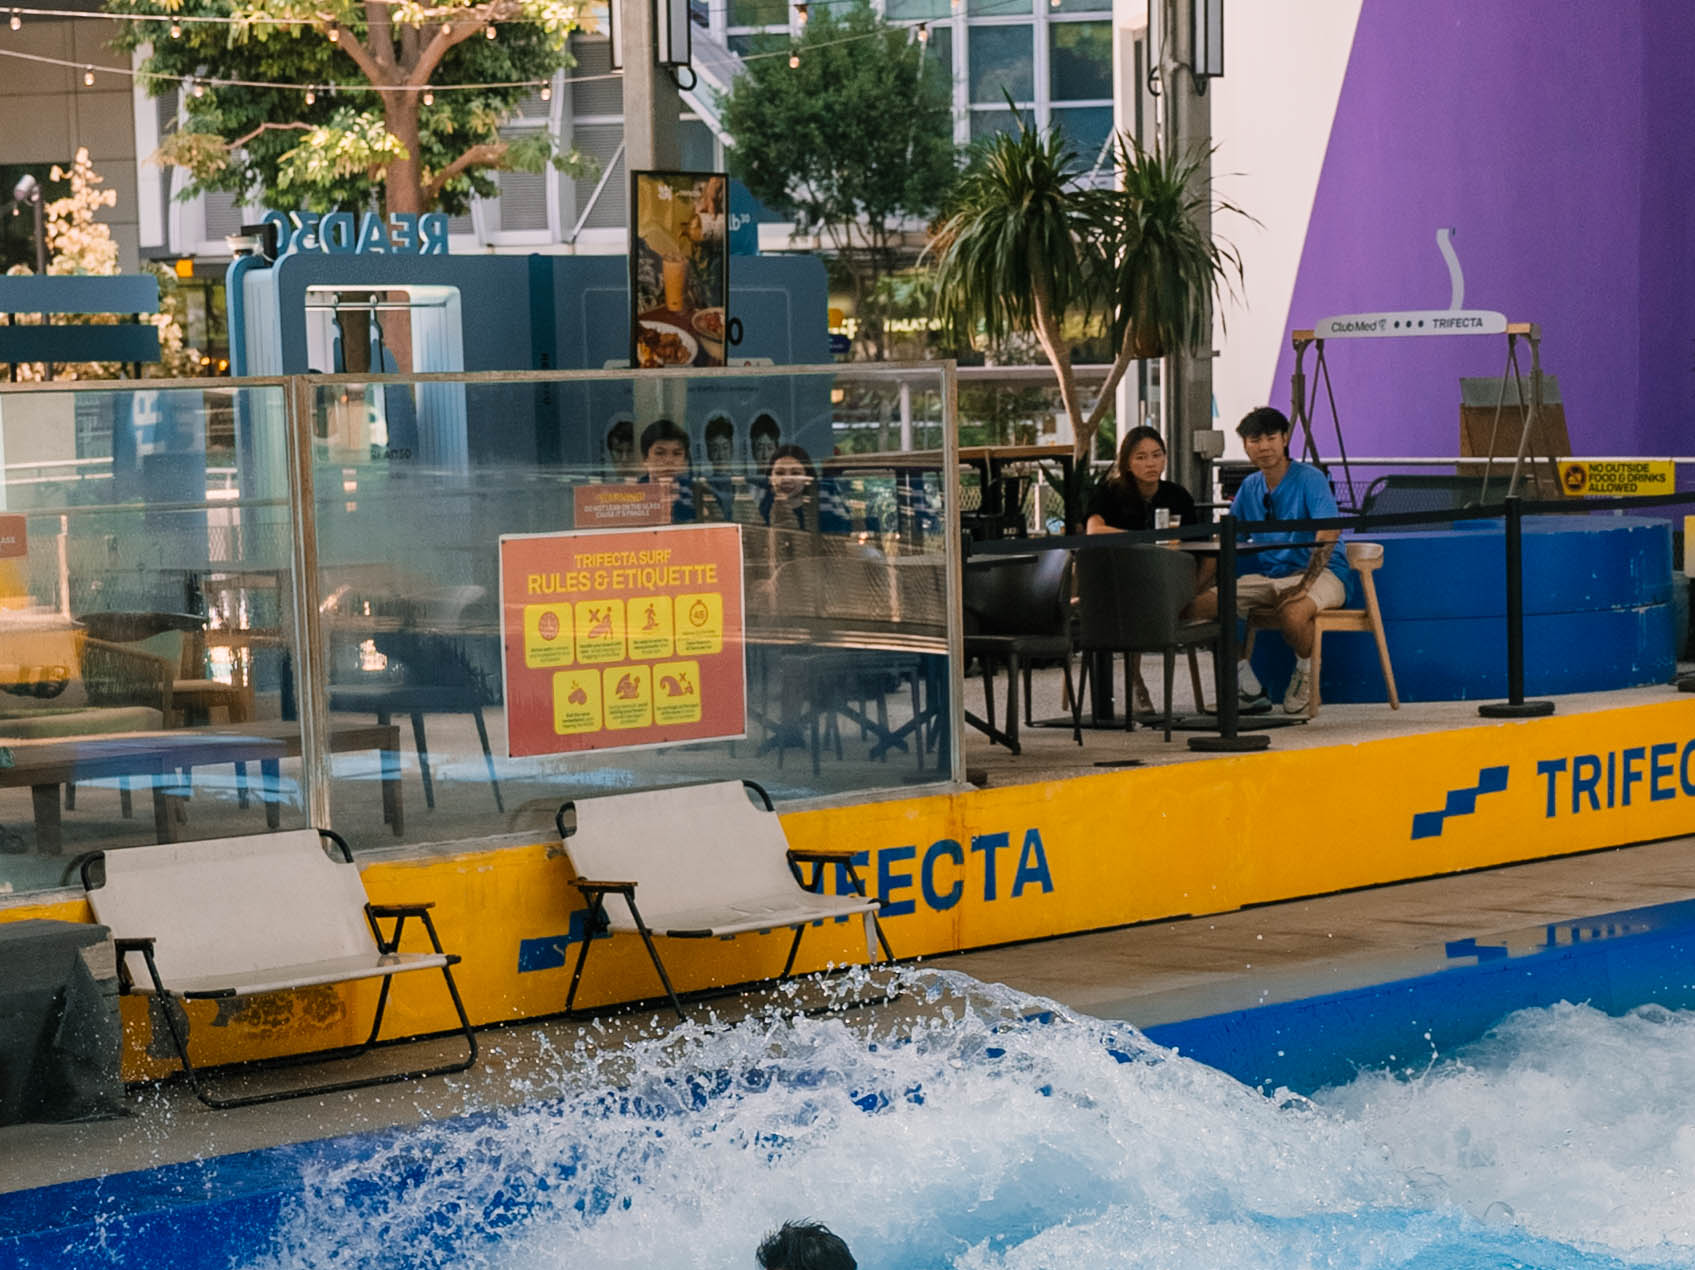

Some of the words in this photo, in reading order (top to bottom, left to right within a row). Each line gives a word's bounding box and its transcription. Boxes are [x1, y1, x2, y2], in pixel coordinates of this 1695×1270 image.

[1432, 317, 1483, 328] TRIFECTA
[1588, 464, 1603, 472] NO
[1605, 463, 1650, 472] OUTSIDE
[1589, 474, 1617, 483] FOOD
[1627, 473, 1666, 482] DRINKS
[1588, 484, 1638, 492] ALLOWED
[574, 551, 638, 568] TRIFECTA
[639, 549, 672, 564] SURF
[527, 571, 591, 594] RULES
[594, 570, 609, 590] &
[612, 564, 718, 589] ETIQUETTE
